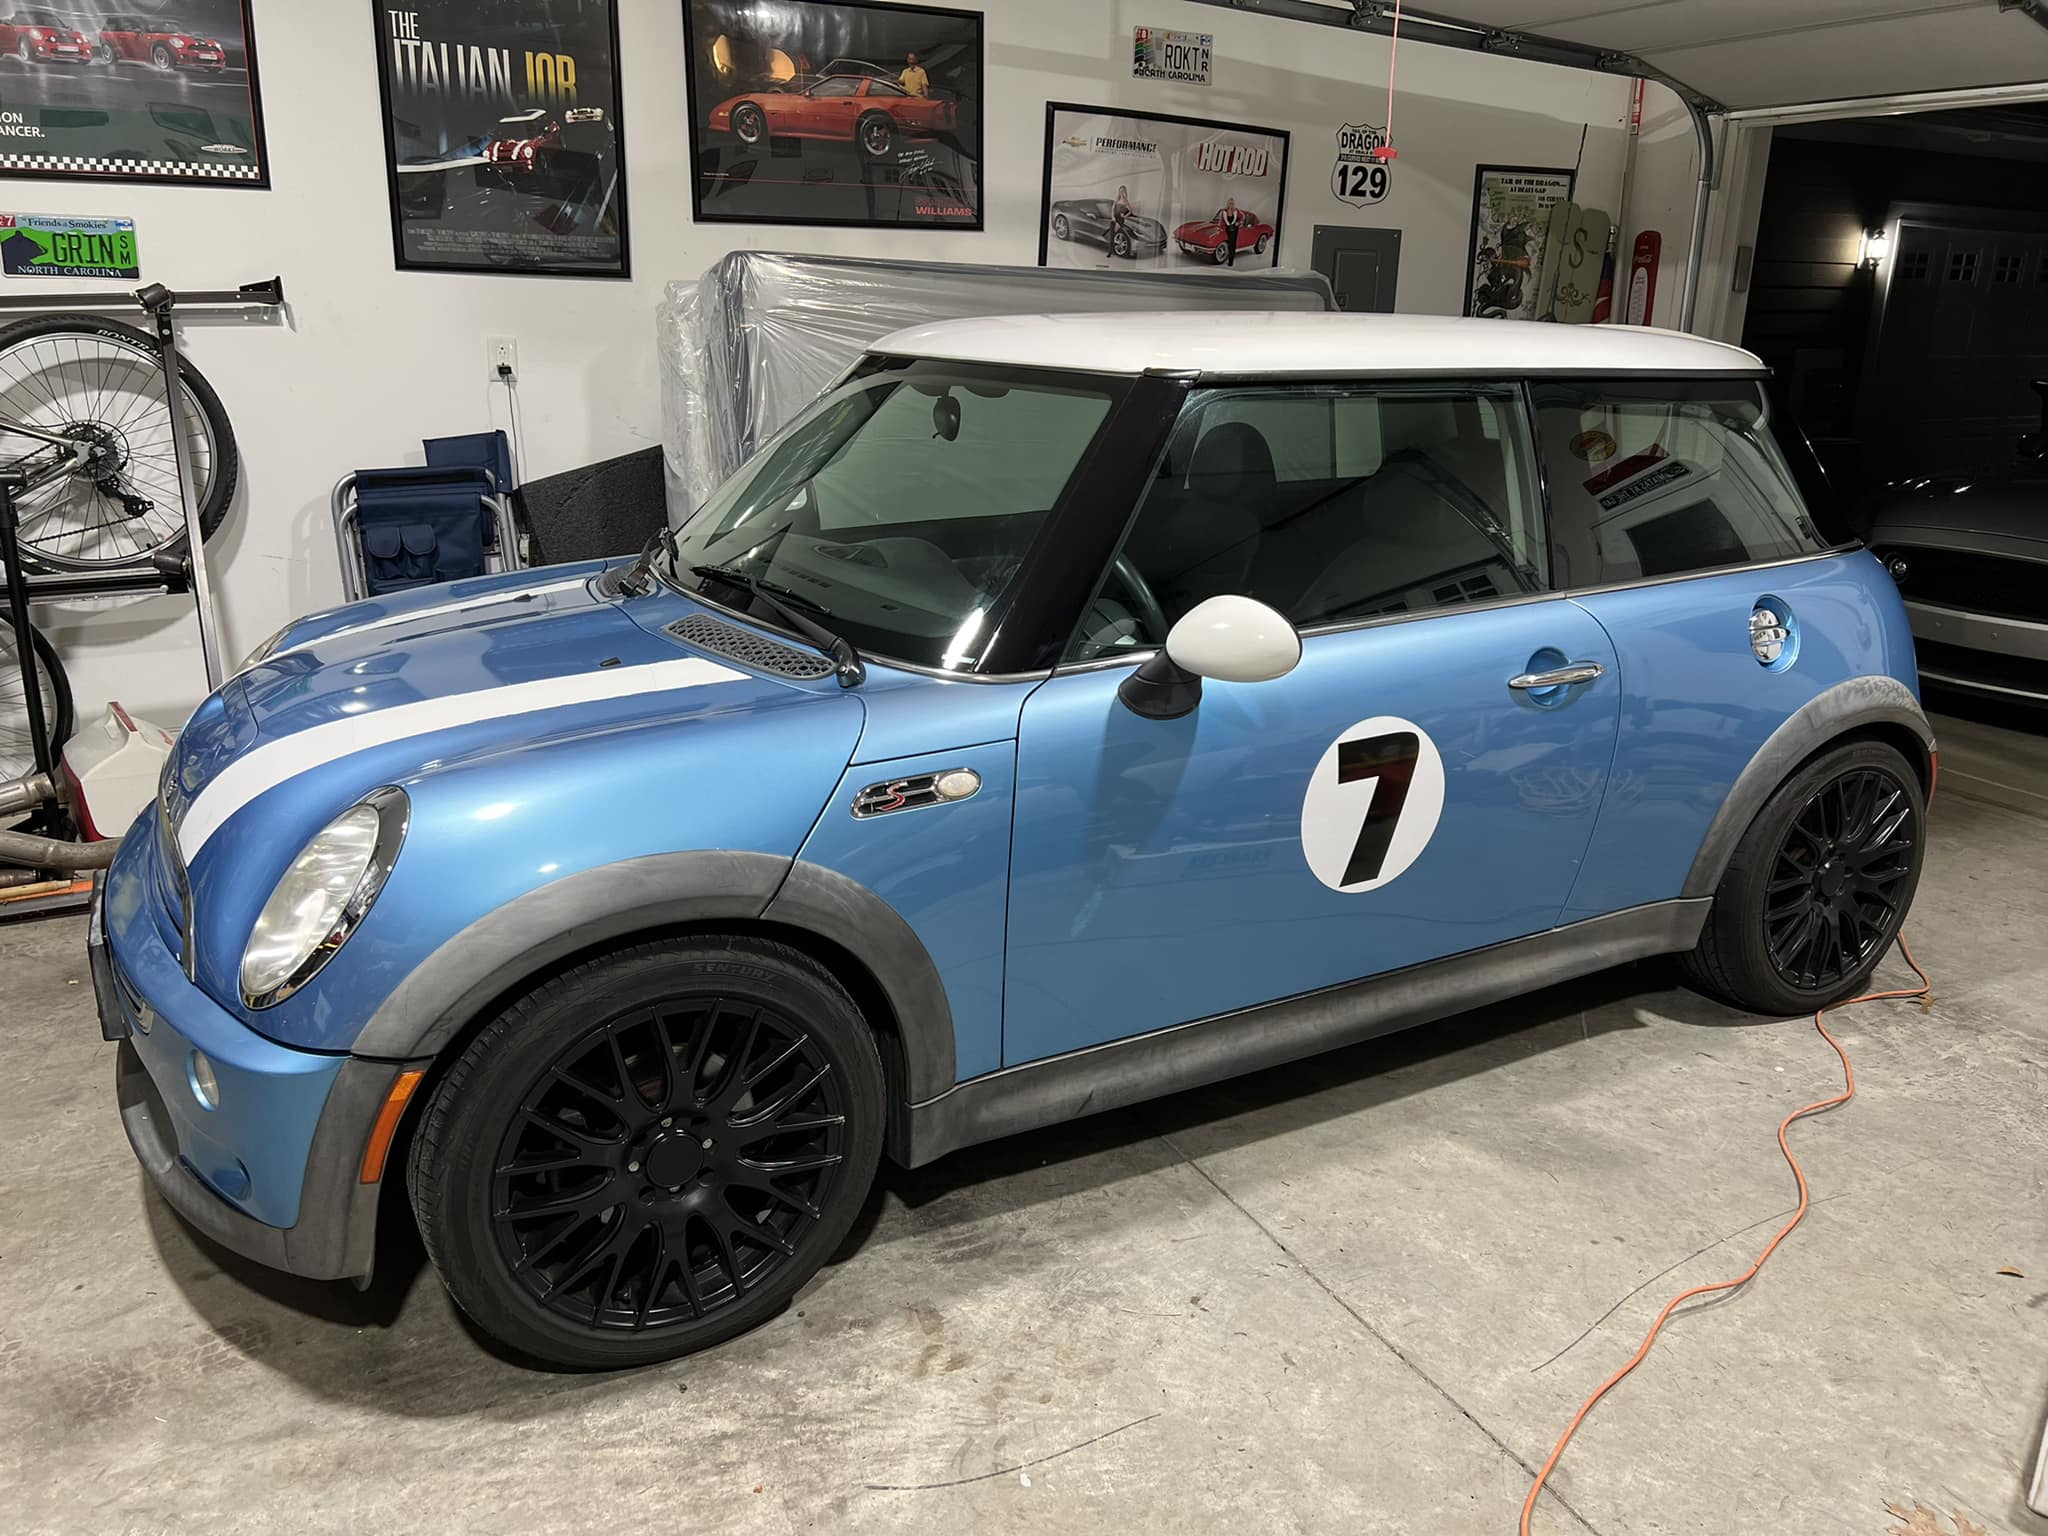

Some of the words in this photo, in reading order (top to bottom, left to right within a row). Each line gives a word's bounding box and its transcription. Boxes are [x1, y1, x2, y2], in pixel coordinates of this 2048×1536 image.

[388, 10, 420, 39] THE
[1165, 44, 1199, 71] ROKT
[393, 39, 512, 100] ITALIAN
[525, 51, 577, 104] JOB
[1168, 71, 1206, 82] CAROLINA
[0, 112, 23, 123] ON
[1095, 137, 1157, 153] PERFORMANCE
[1341, 131, 1387, 150] DRAGON
[1198, 143, 1233, 173] HOT
[1231, 146, 1269, 177] ROD
[1338, 164, 1387, 199] 129
[28, 217, 61, 227] Friends
[68, 219, 107, 229] Smokies
[915, 206, 973, 216] WILLIAMS
[52, 232, 115, 264] GRIN
[1569, 227, 1588, 269] S
[17, 265, 58, 275] NORTH
[64, 266, 122, 277] CAROLINA
[1338, 731, 1420, 888] 7
